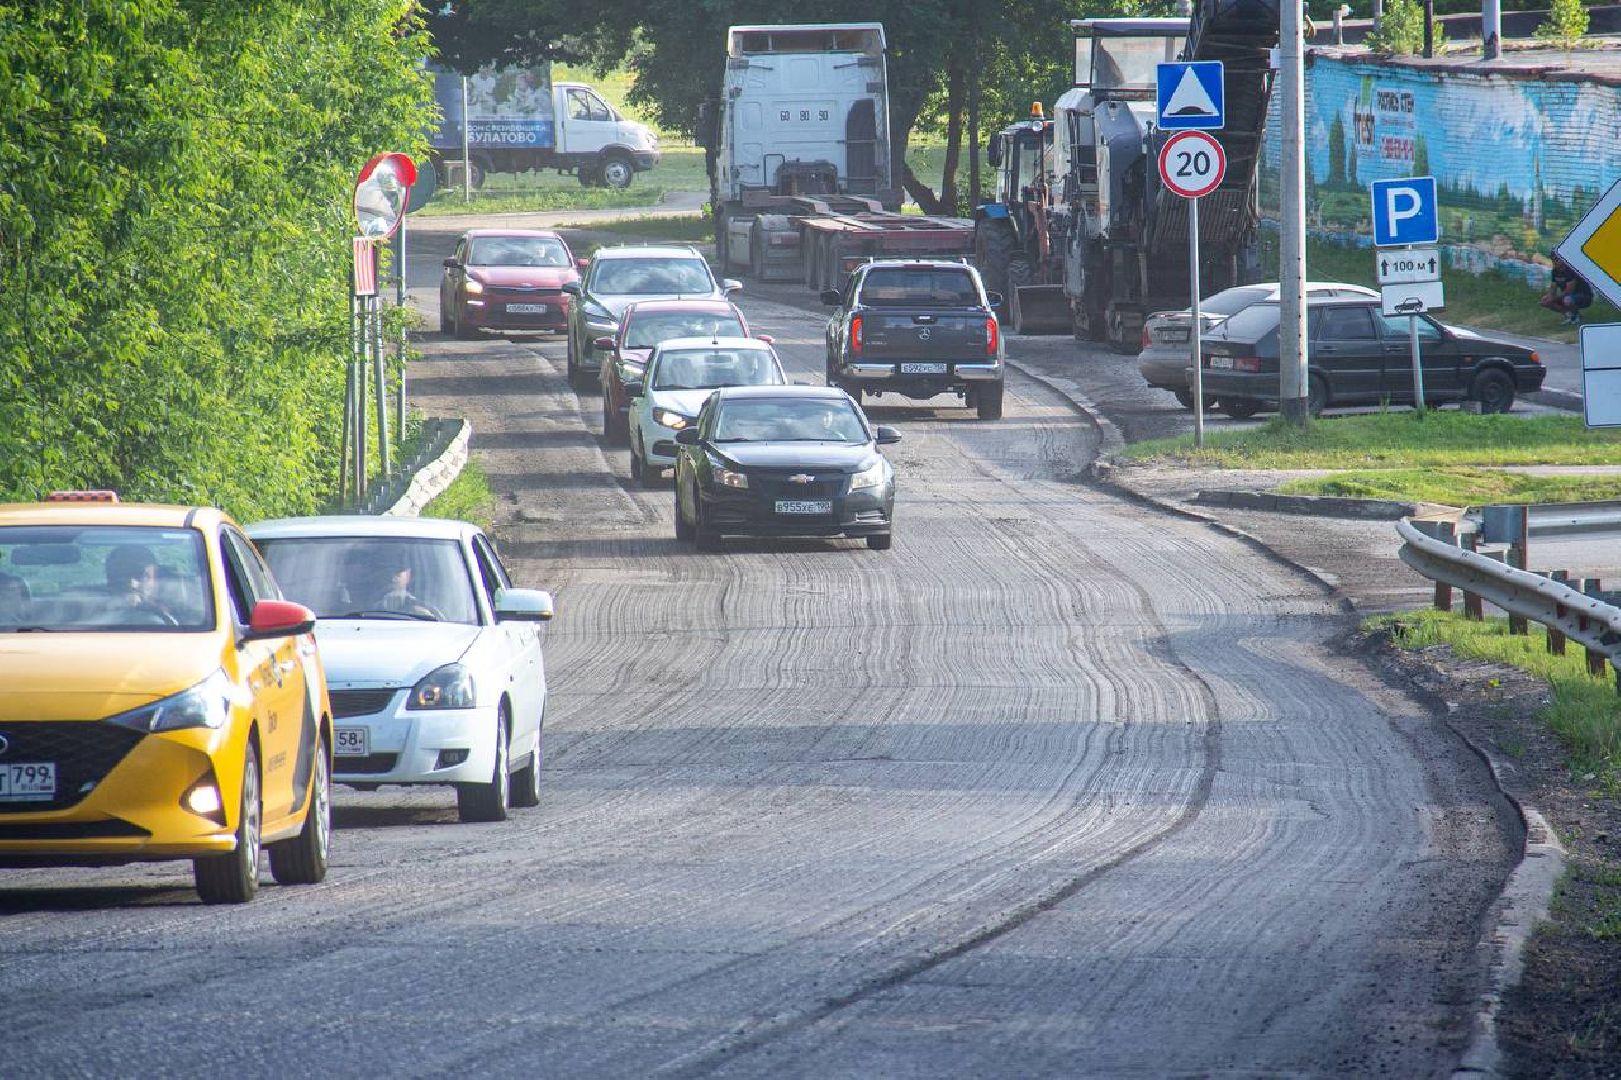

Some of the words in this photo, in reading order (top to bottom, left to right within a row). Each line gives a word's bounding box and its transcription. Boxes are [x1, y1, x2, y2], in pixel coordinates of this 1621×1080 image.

[467, 131, 537, 143] БУЛАТОВО
[1176, 151, 1211, 177] 20
[1387, 187, 1422, 237] P
[1393, 261, 1414, 272] 100
[339, 732, 357, 746] 58
[12, 766, 50, 784] 799
